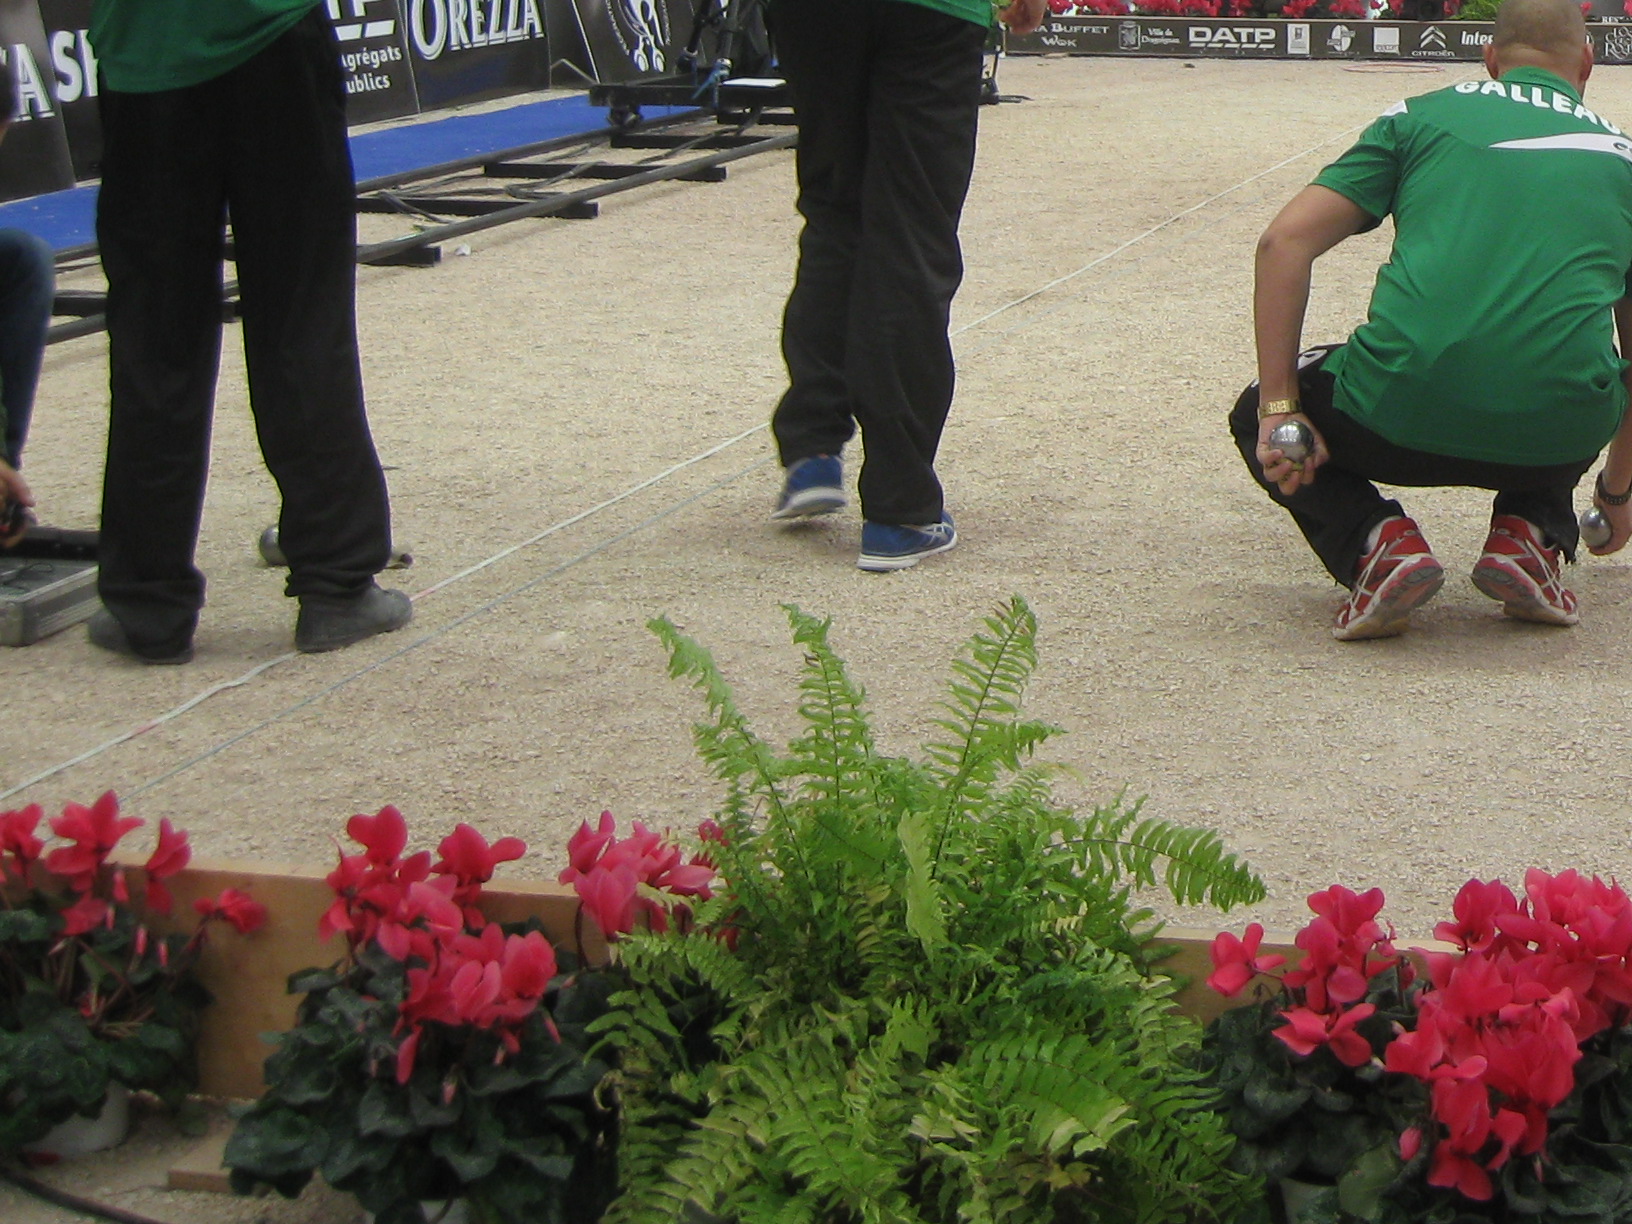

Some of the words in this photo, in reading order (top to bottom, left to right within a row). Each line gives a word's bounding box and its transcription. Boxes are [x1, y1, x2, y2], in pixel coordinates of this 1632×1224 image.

[1050, 22, 1110, 34] BUFFET
[1189, 26, 1276, 43] DATP
[346, 73, 391, 94] ublics
